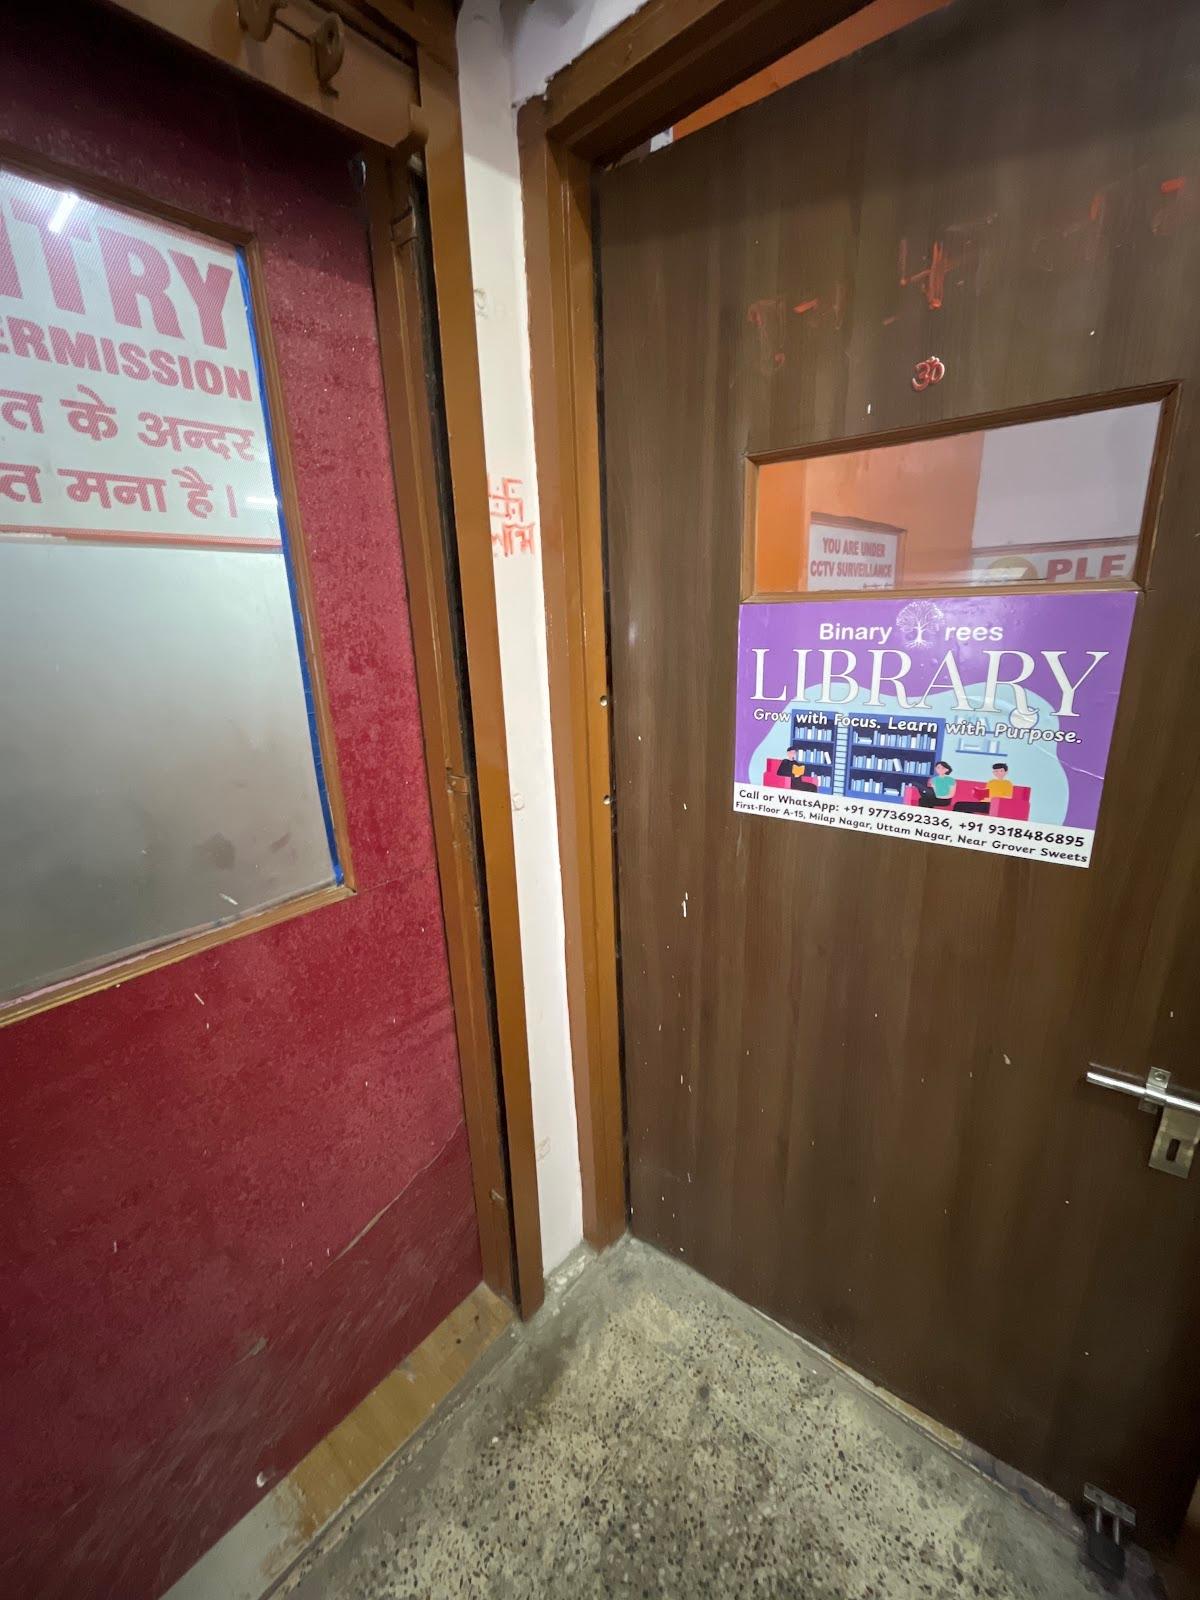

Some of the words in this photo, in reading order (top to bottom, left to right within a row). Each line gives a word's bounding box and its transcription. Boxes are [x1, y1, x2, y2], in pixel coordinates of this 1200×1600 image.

[60, 384, 119, 441] के
[137, 411, 255, 461] अन्दर
[57, 468, 167, 513] मना
[810, 560, 834, 577] CCTV
[836, 562, 892, 578] SURVEILLANCE
[823, 537, 841, 554] YOU
[843, 540, 859, 555] ARE
[861, 542, 886, 558] UNDER
[819, 622, 893, 644] Binary
[944, 625, 1004, 642] rees
[750, 648, 1110, 718] LIBRARY
[753, 708, 790, 722] Grow
[796, 711, 828, 726] with
[834, 713, 881, 729] Focus.
[888, 716, 938, 733] Learn
[945, 720, 987, 737] with
[995, 722, 1083, 744] Purpose.
[735, 800, 781, 814] First-Floor
[783, 808, 806, 820] A-15,
[809, 812, 836, 825] Milap
[838, 817, 873, 830] Nagar,
[876, 822, 911, 835] Uttam
[914, 828, 953, 843] Nagar,
[957, 834, 987, 847] Near
[991, 840, 1036, 854] Grover
[1040, 847, 1088, 863] Sweets
[739, 789, 759, 800] Call
[763, 793, 775, 802] or
[778, 795, 839, 812] WhatsApp:
[844, 805, 864, 815] +91
[868, 807, 953, 830] 9773692336,
[959, 820, 983, 833] +91
[988, 824, 1085, 848] 9318486895
